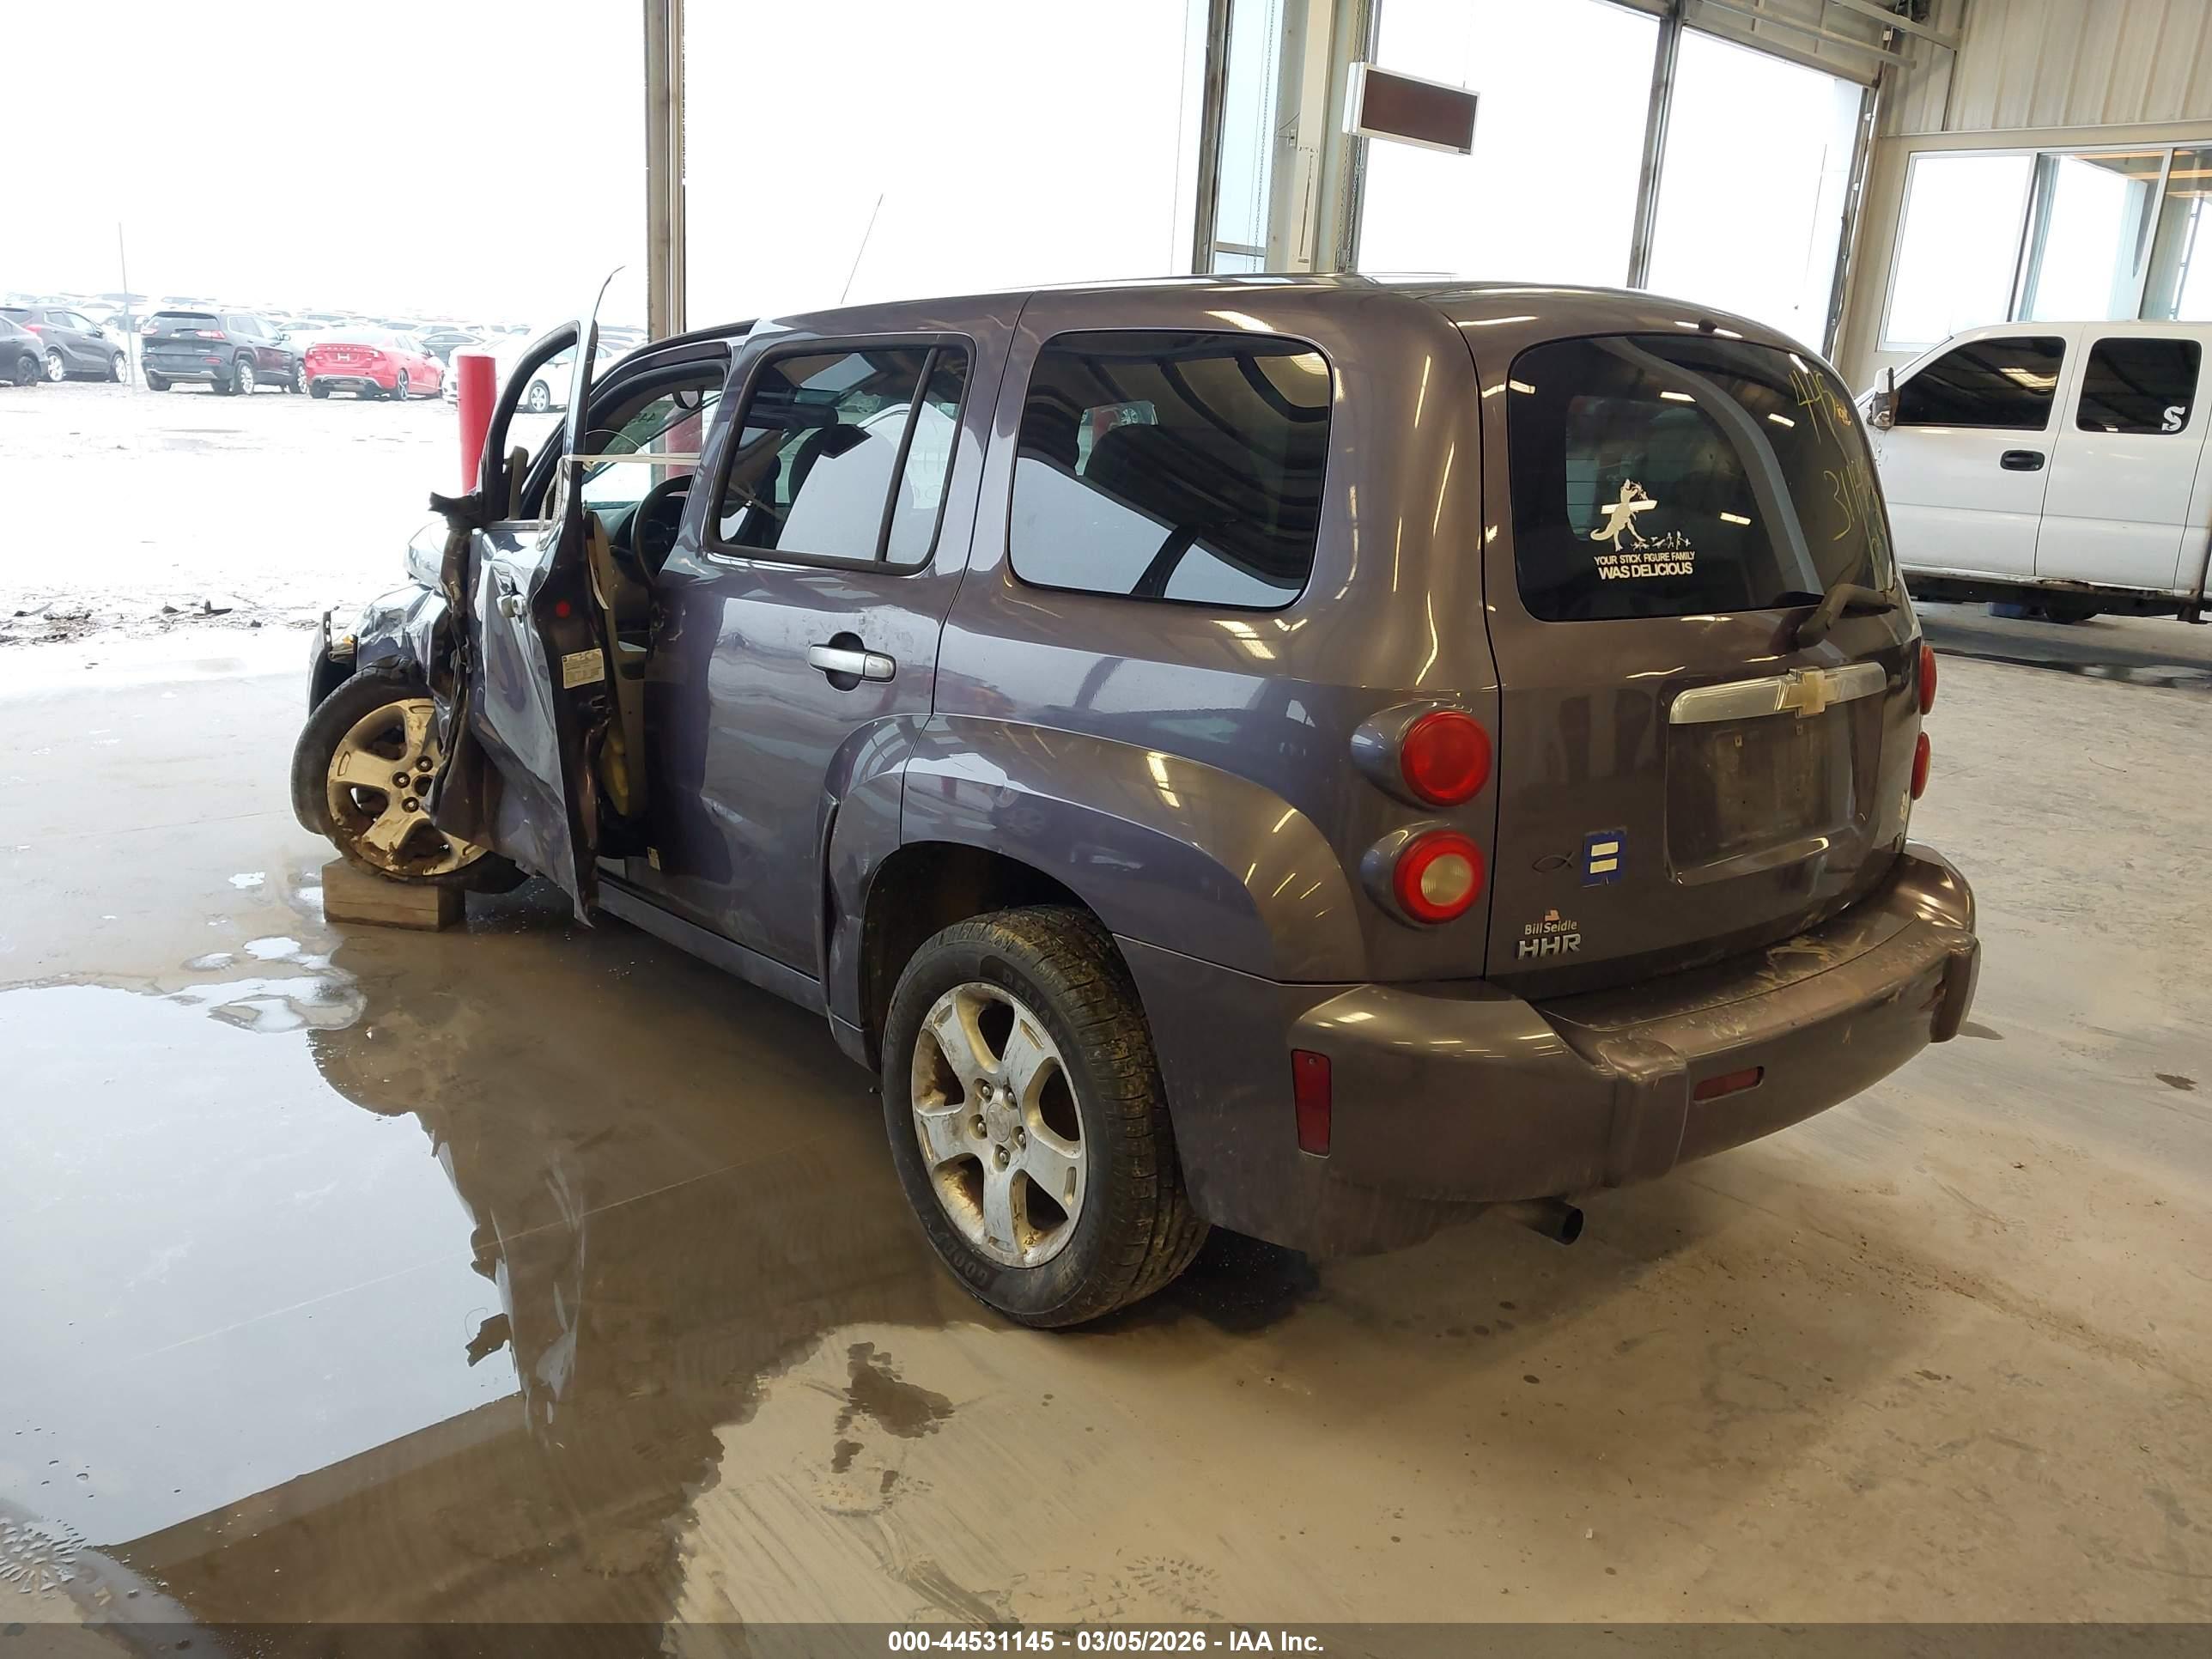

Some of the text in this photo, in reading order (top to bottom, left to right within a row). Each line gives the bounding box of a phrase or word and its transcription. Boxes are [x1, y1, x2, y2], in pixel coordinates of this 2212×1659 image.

[2161, 406, 2186, 432] S
[1594, 550, 1696, 566] YOUR STICK FIGURE FAMILY
[1597, 562, 1693, 580] WAS DELICIOUS
[1524, 920, 1577, 935] Bill Seidle
[1517, 933, 1582, 961] HHR
